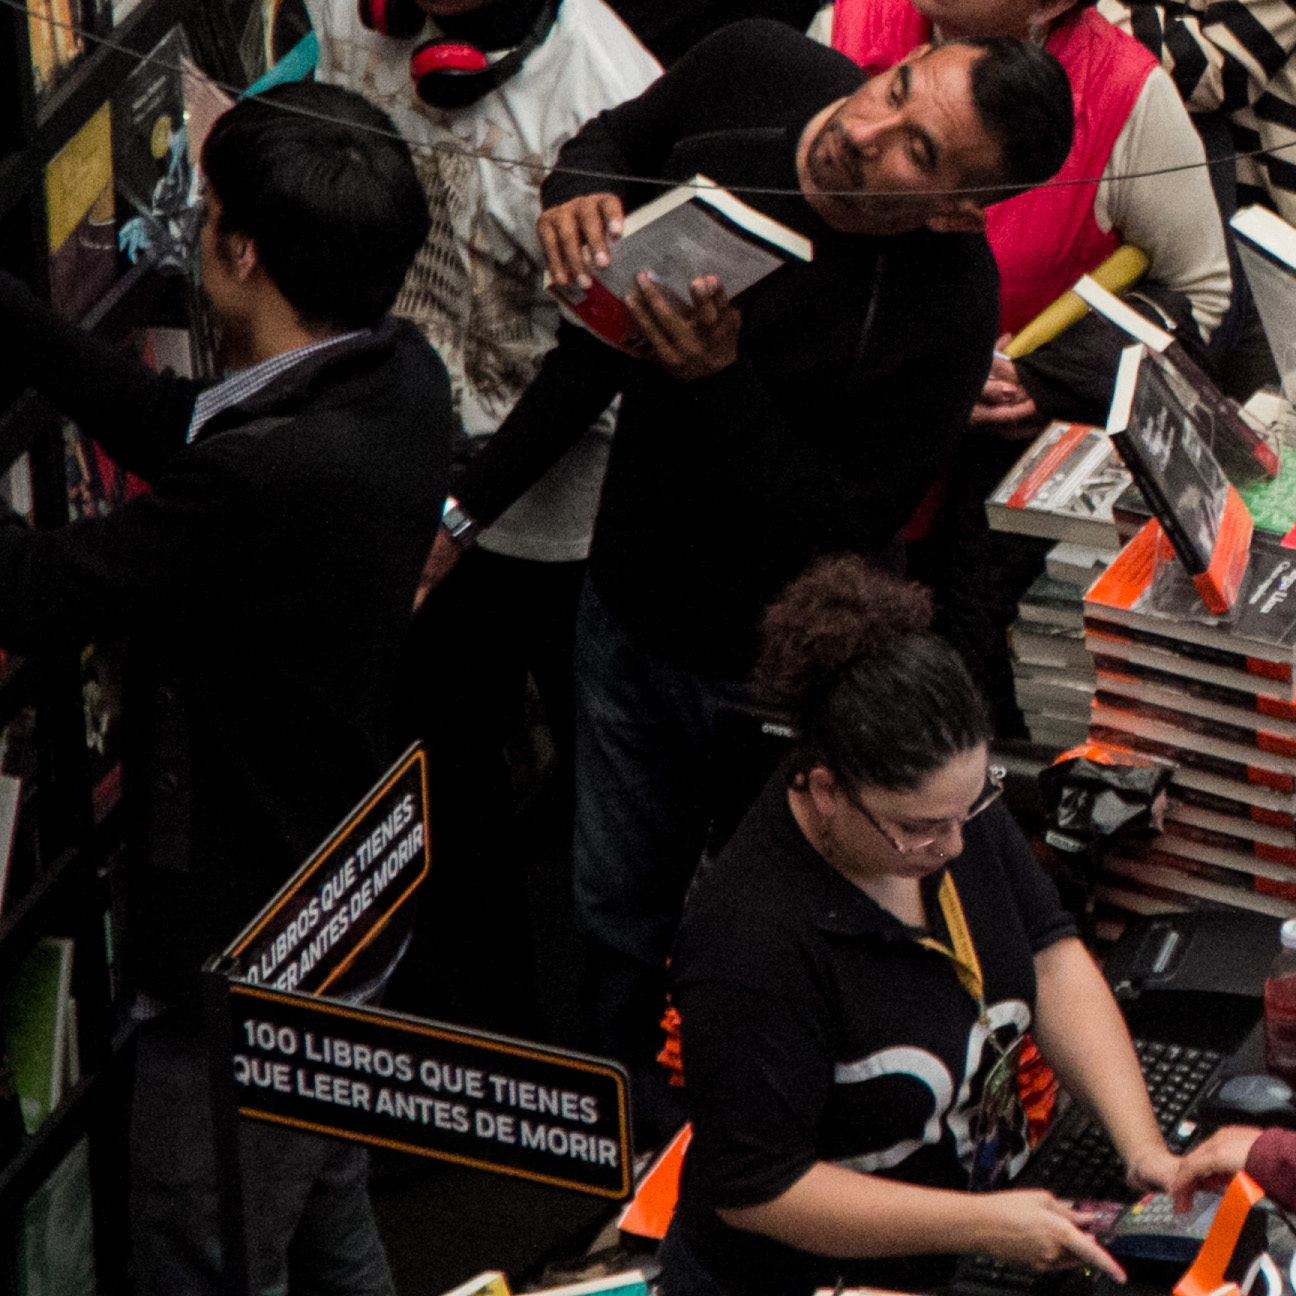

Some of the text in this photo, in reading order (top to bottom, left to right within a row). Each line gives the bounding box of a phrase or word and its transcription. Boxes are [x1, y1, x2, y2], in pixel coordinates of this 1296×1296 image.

[262, 794, 415, 980] LIBROS QUE TIENES
[299, 822, 424, 979] ANTES DE MORIR
[233, 1054, 619, 1168] QUE LEER ANTES DE MORIR
[243, 1019, 599, 1125] 100 LIBROS QUE TIENES
